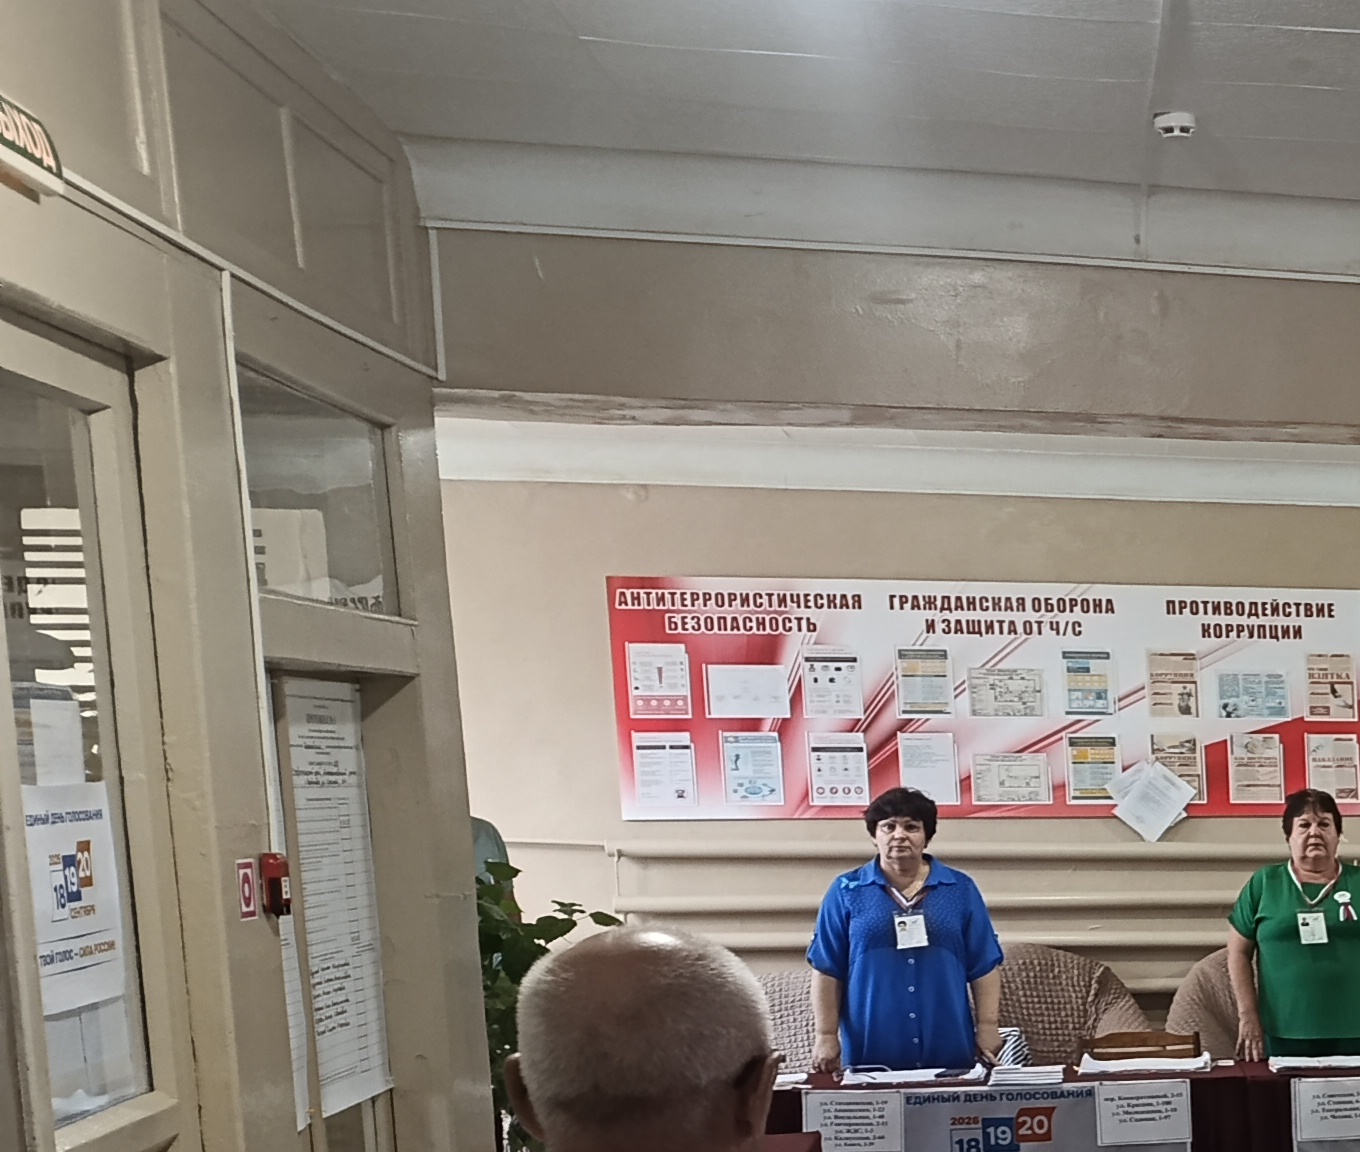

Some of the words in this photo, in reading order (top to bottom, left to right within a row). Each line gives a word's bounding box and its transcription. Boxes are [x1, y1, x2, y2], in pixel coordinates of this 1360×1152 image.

[0, 101, 56, 173] ЫХОД
[616, 590, 863, 610] АНТИТЕРРОРИСТИЧЕСКАЯ
[888, 593, 1026, 613] ГРАЖДАНСКАЯ
[1031, 596, 1116, 615] ОБОРОНА
[1165, 598, 1336, 619] ПРОТИВОДЕЙСТВИЕ
[667, 615, 818, 633] БЕЗОПАСНОСТЬ
[925, 618, 936, 635] И
[941, 618, 1019, 637] ЗАЩИТА
[1022, 620, 1044, 636] ОТ
[1049, 620, 1083, 637] Ч/С
[1200, 623, 1303, 641] КОРРУПЦИИ
[78, 851, 91, 877] 20
[64, 866, 77, 892] 19
[54, 884, 66, 910] 18
[905, 1092, 960, 1105] ЕДИНЫЙ
[963, 1092, 998, 1104] ДЕНЬ
[1000, 1088, 1093, 1102] ГОЛОСОВАНИЯ
[950, 1116, 980, 1126] 2026
[1017, 1115, 1049, 1135] 20
[985, 1126, 1012, 1145] 19
